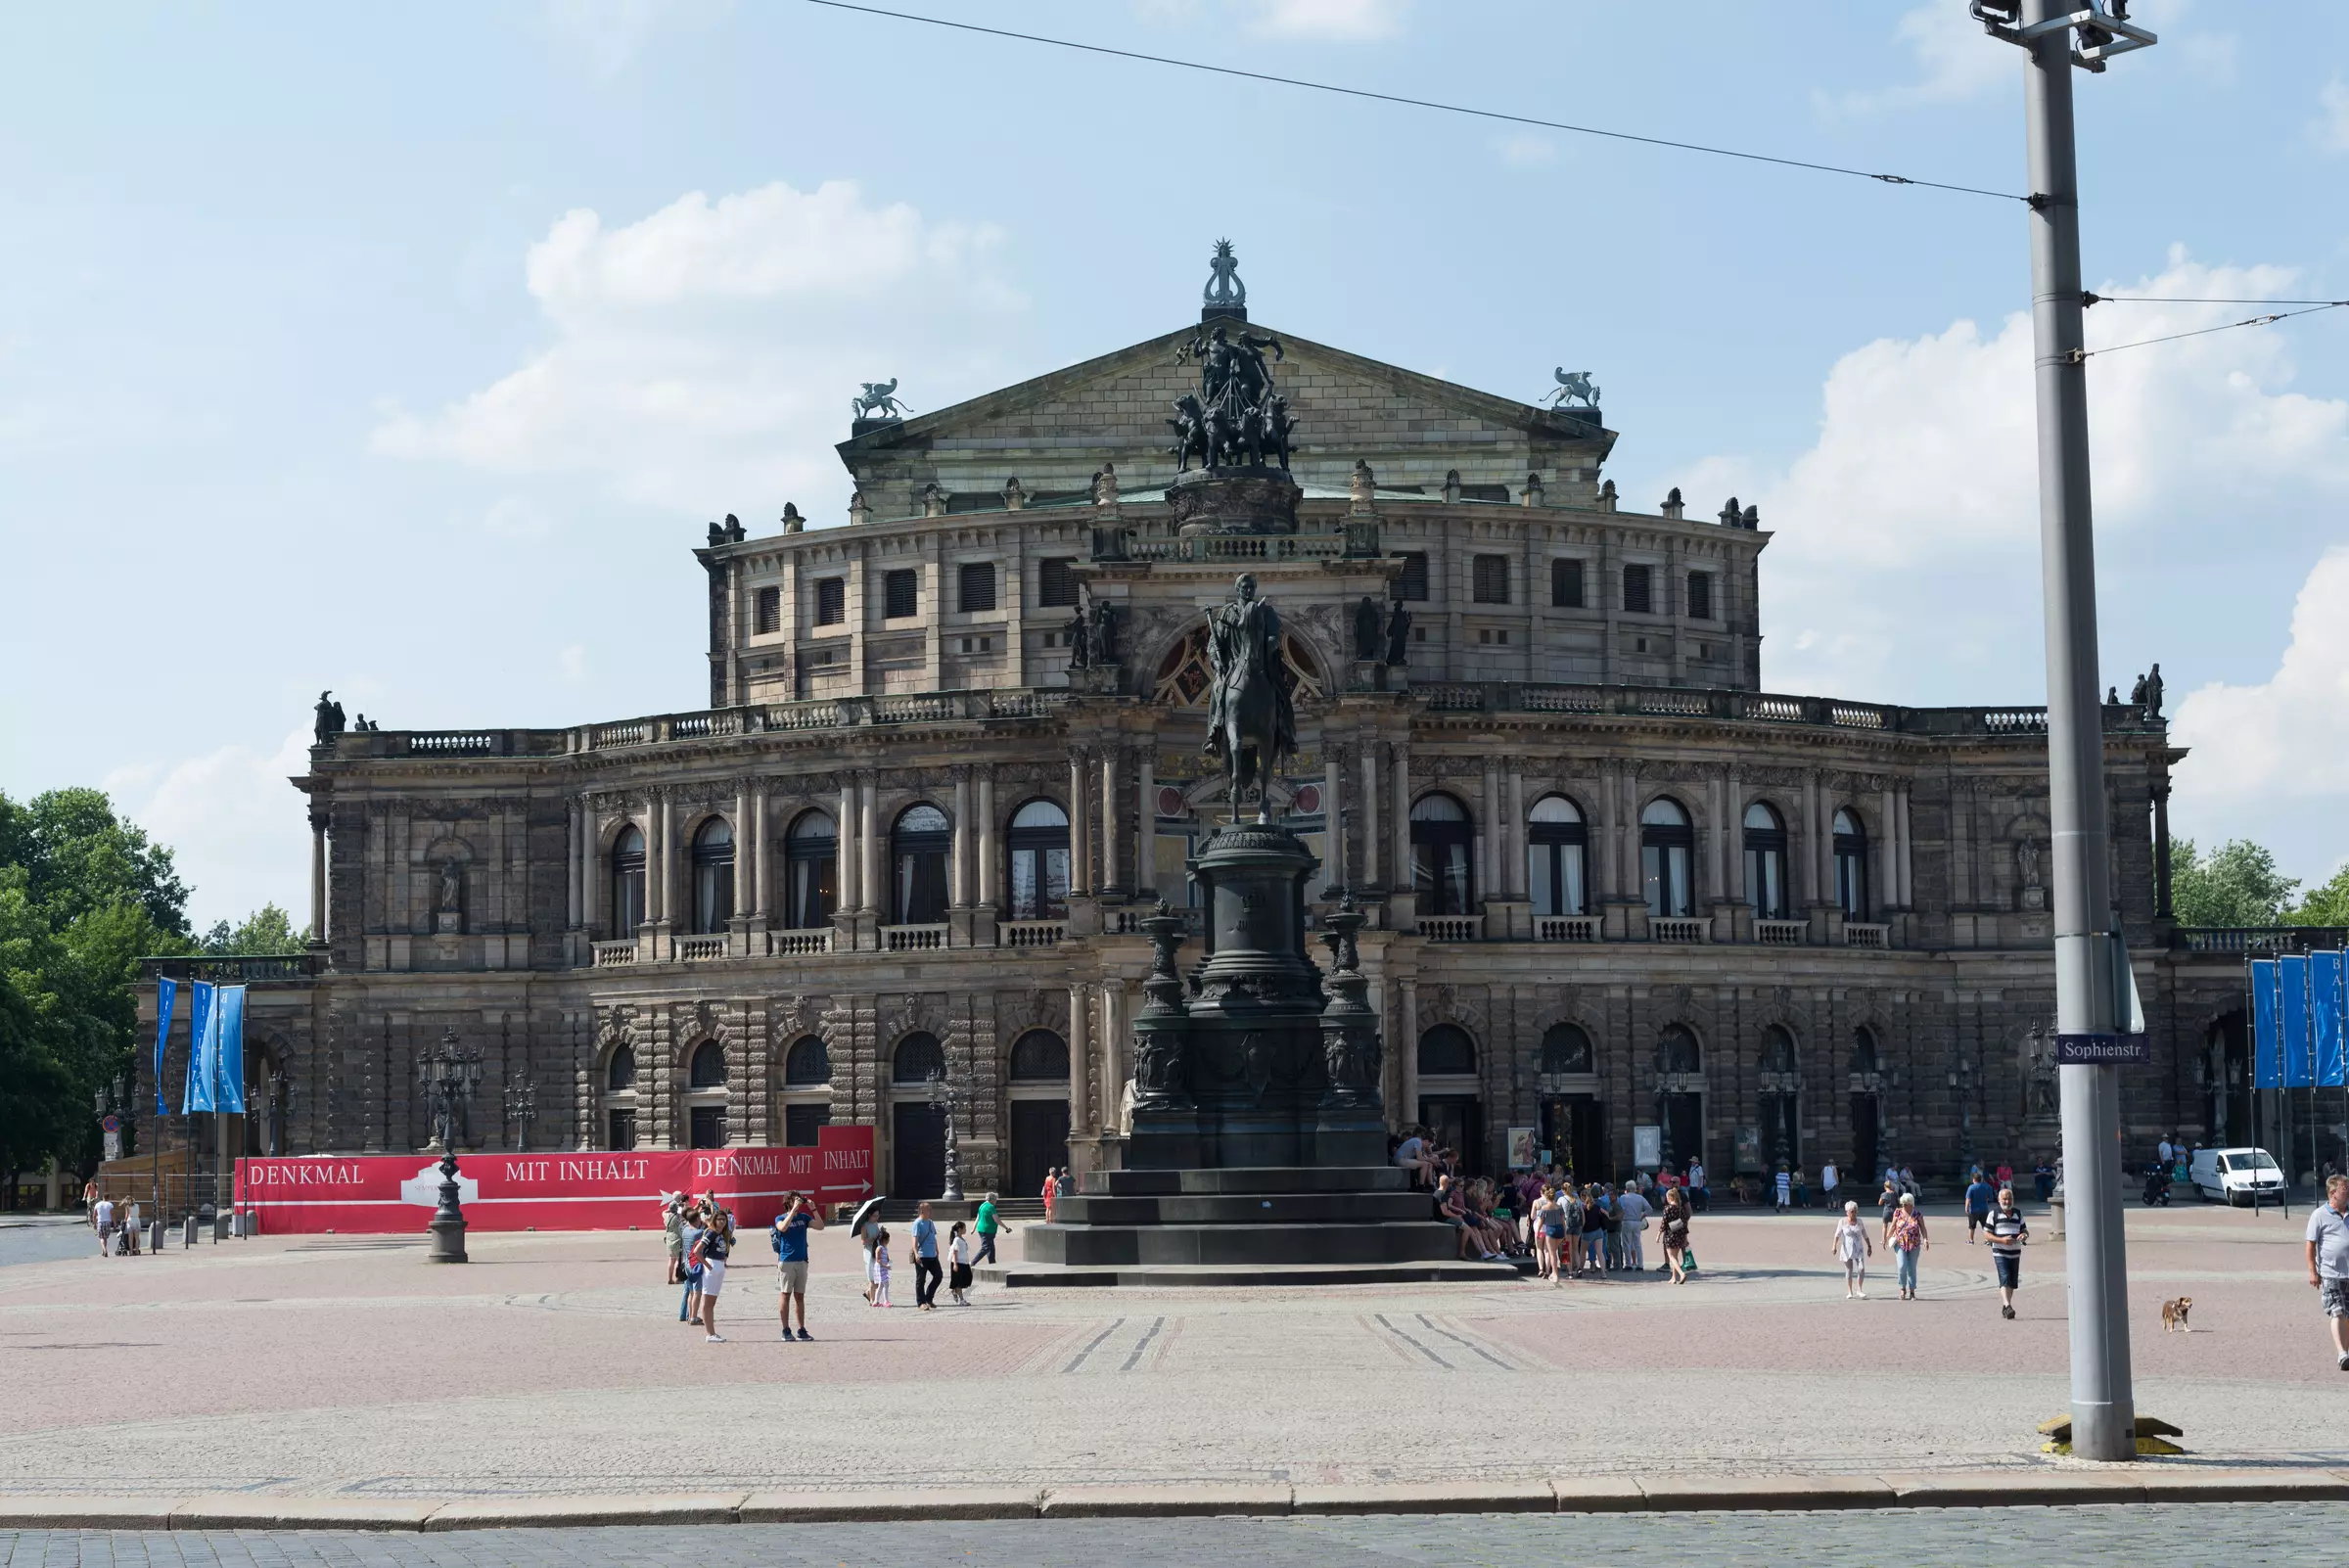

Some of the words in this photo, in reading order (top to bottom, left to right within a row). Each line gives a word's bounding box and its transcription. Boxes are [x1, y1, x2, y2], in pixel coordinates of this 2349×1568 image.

[2064, 1041, 2144, 1059] Sophienstr.
[250, 1165, 364, 1185] DENKMAL
[505, 1162, 550, 1181] MIT
[559, 1159, 650, 1180] INHALT
[697, 1155, 781, 1177] DENKMAL
[789, 1155, 813, 1175] MIT
[823, 1149, 870, 1170] INHALT
